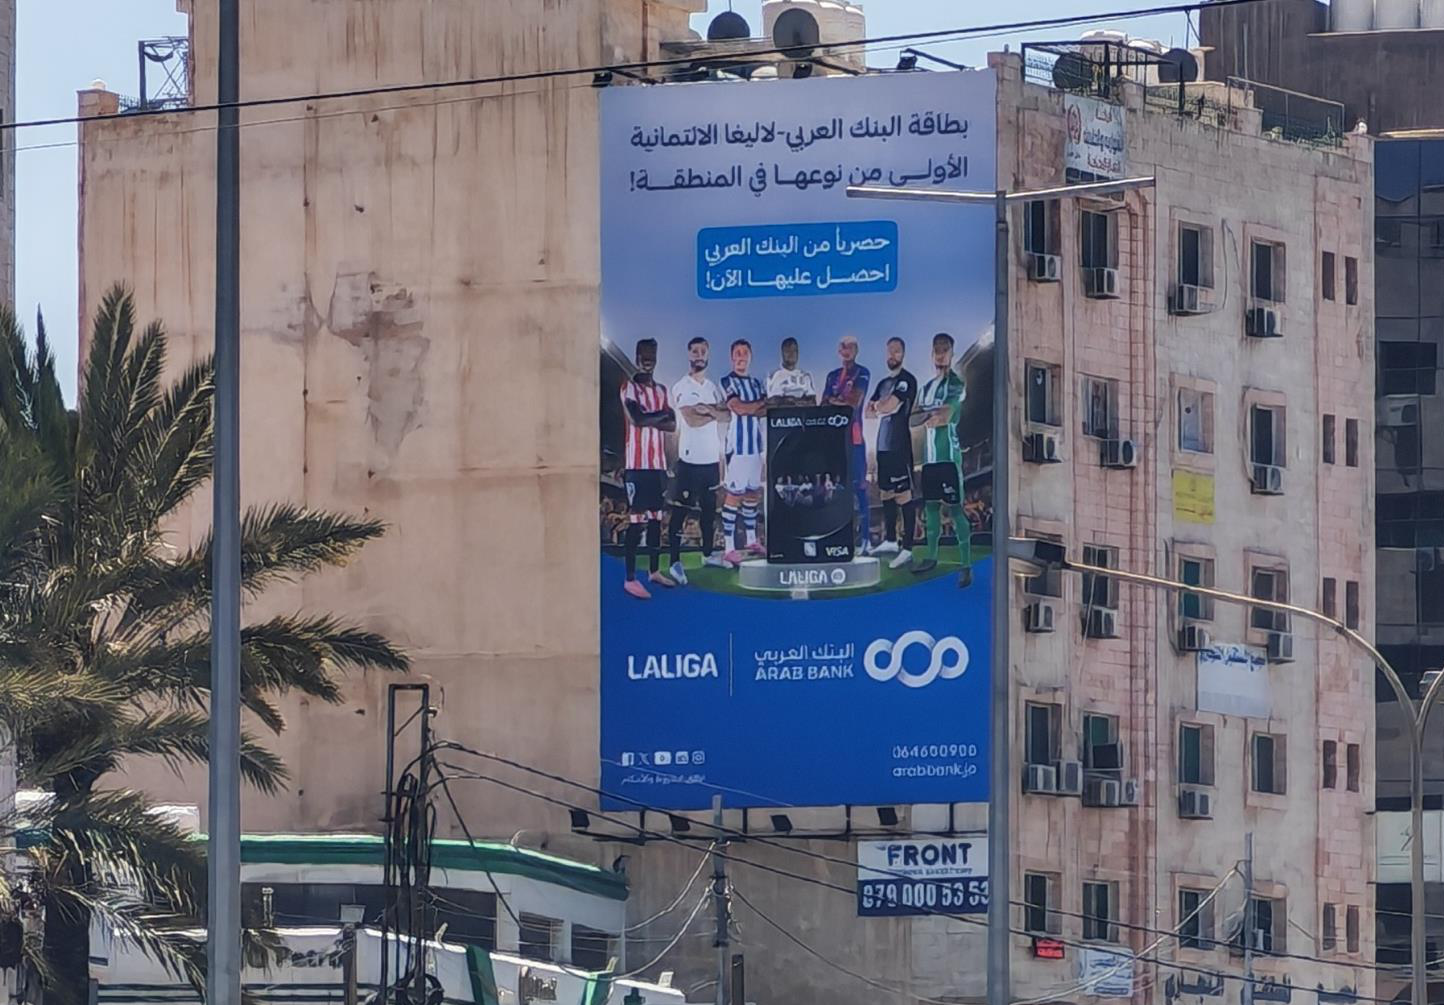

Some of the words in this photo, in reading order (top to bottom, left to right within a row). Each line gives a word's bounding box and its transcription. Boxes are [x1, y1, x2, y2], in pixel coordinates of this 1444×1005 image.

[850, 114, 900, 141] البنك
[909, 112, 968, 137] بطاقة
[749, 162, 767, 198] في
[774, 163, 843, 190] نوعها
[849, 168, 881, 187] من
[889, 156, 967, 187] الأولى
[705, 237, 751, 266] العربي
[756, 234, 798, 254] البنك
[803, 240, 829, 257] من
[748, 267, 811, 290] عليها
[817, 263, 890, 284] احصل
[755, 646, 808, 666] العربي
[812, 643, 855, 664] البنك
[628, 653, 718, 680] LALIGA
[755, 666, 804, 681] ARAB
[808, 664, 855, 680] BANK
[887, 843, 972, 867] FRONT
